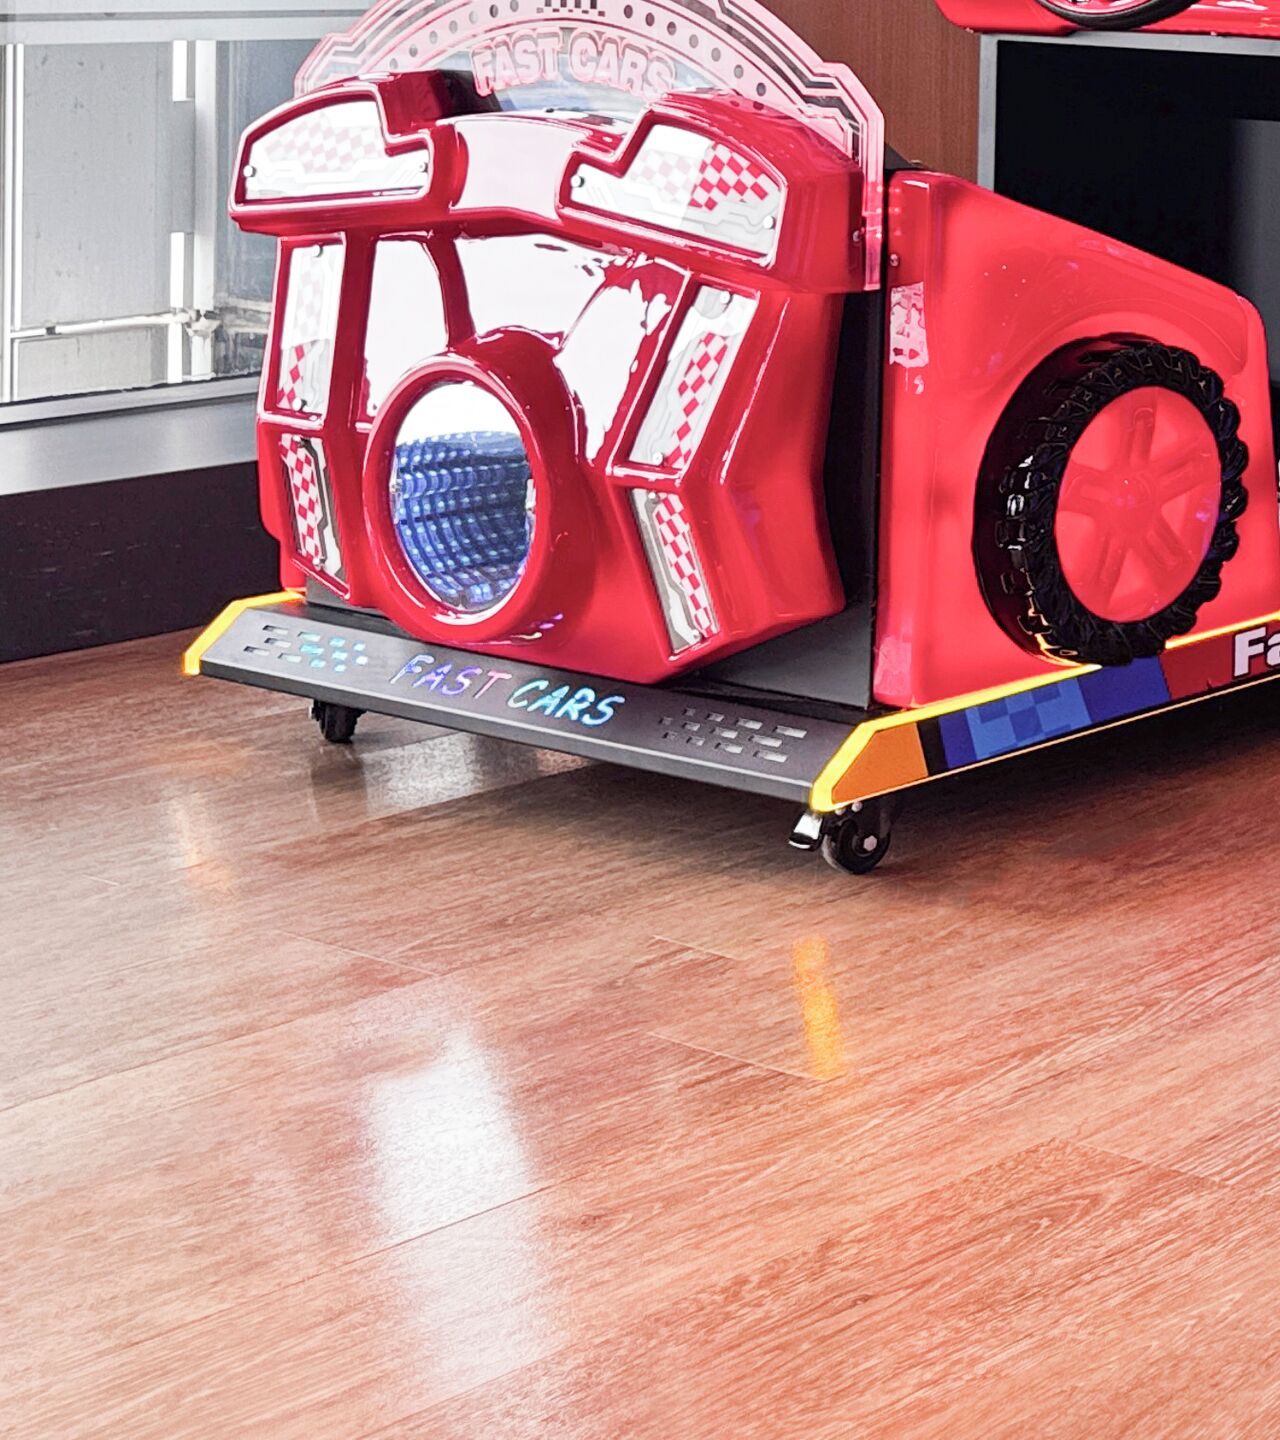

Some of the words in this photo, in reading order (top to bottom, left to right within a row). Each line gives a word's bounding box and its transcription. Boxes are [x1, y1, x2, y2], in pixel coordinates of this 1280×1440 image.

[473, 28, 562, 96] FAST
[569, 27, 676, 102] CARS
[390, 654, 512, 700] FAST
[507, 679, 625, 725] CARS
